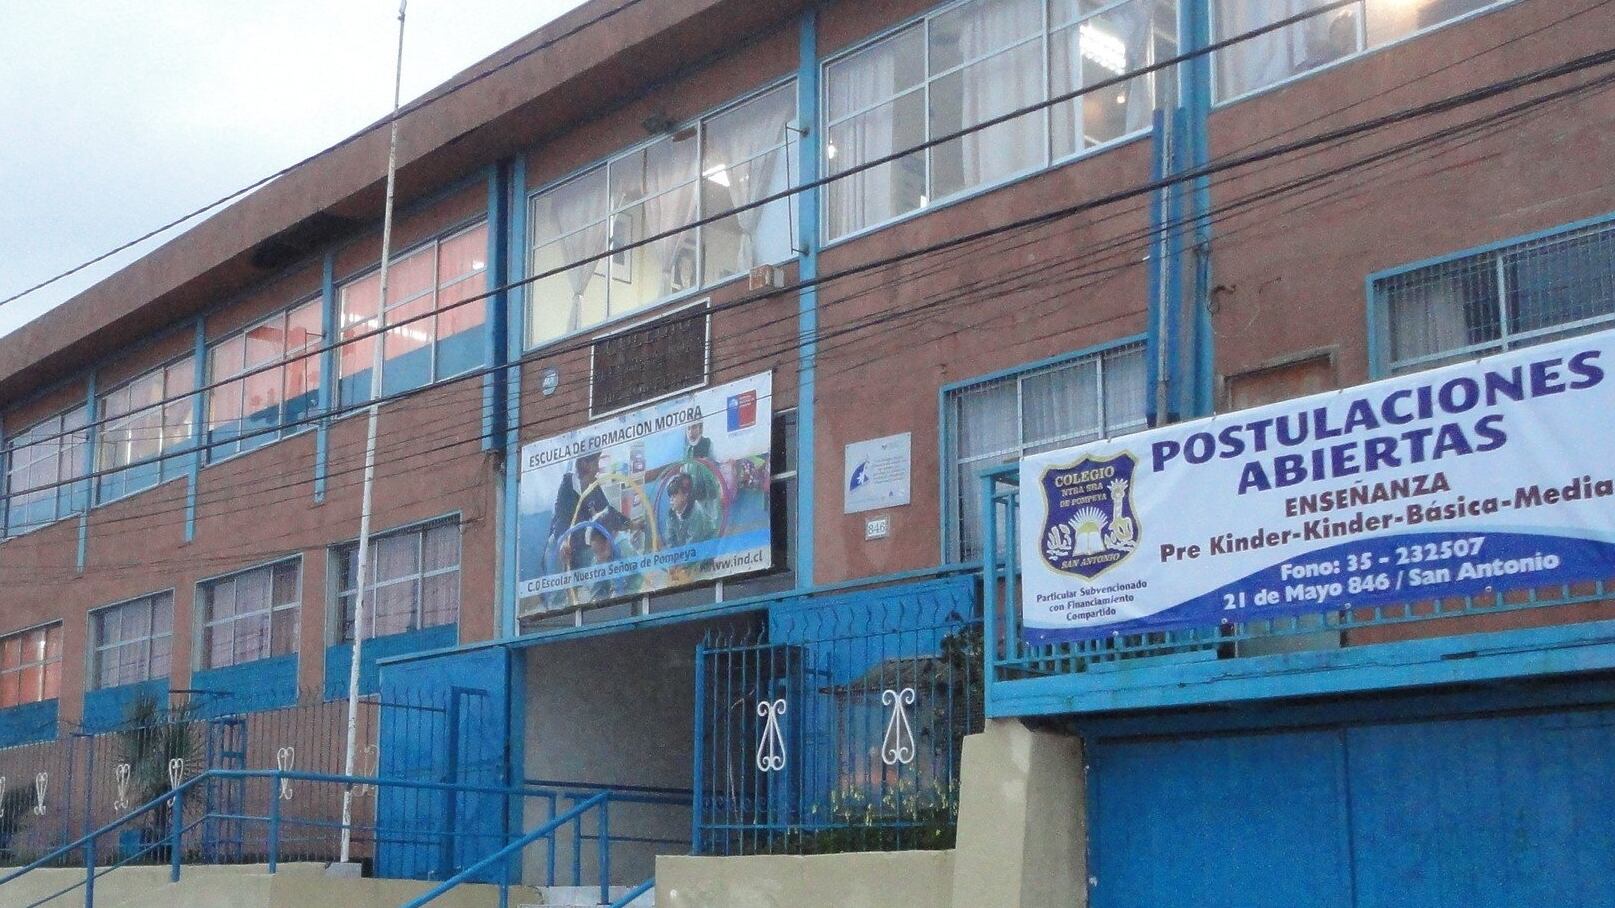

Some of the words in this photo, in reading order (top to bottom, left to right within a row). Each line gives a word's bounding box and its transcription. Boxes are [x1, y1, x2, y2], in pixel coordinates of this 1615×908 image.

[1152, 349, 1605, 472] POSTULACIONES
[529, 445, 571, 467] ESCUELA
[573, 439, 586, 454] DE
[588, 420, 652, 449] FORMACION
[655, 405, 703, 430] MOTORA
[1237, 413, 1508, 495] ABIERTAS
[1054, 465, 1115, 487] COLEGIO
[1285, 472, 1450, 517] ENSEÑANZA
[868, 521, 886, 535] 846
[574, 568, 606, 582] Nuestra
[608, 560, 638, 575] Señora
[640, 558, 651, 569] de
[654, 548, 697, 565] Pompeya
[1060, 557, 1080, 569] SAN
[1080, 552, 1121, 567] ANTONIO
[1160, 543, 1201, 562] Pre
[1281, 559, 1340, 581] Fono:
[1347, 551, 1372, 573] 35
[1395, 536, 1485, 566] 232507
[1036, 589, 1077, 602] Particular
[1080, 580, 1147, 597] Subvencionado
[1223, 591, 1246, 610] 21
[1254, 588, 1280, 606] de
[1285, 582, 1343, 604] Mayo
[1348, 573, 1390, 595] 846
[1408, 567, 1450, 587] San
[1456, 552, 1561, 581] Antonio
[1049, 602, 1065, 612] con
[1067, 593, 1134, 609] Financiamiento
[1066, 606, 1116, 621] Compartido
